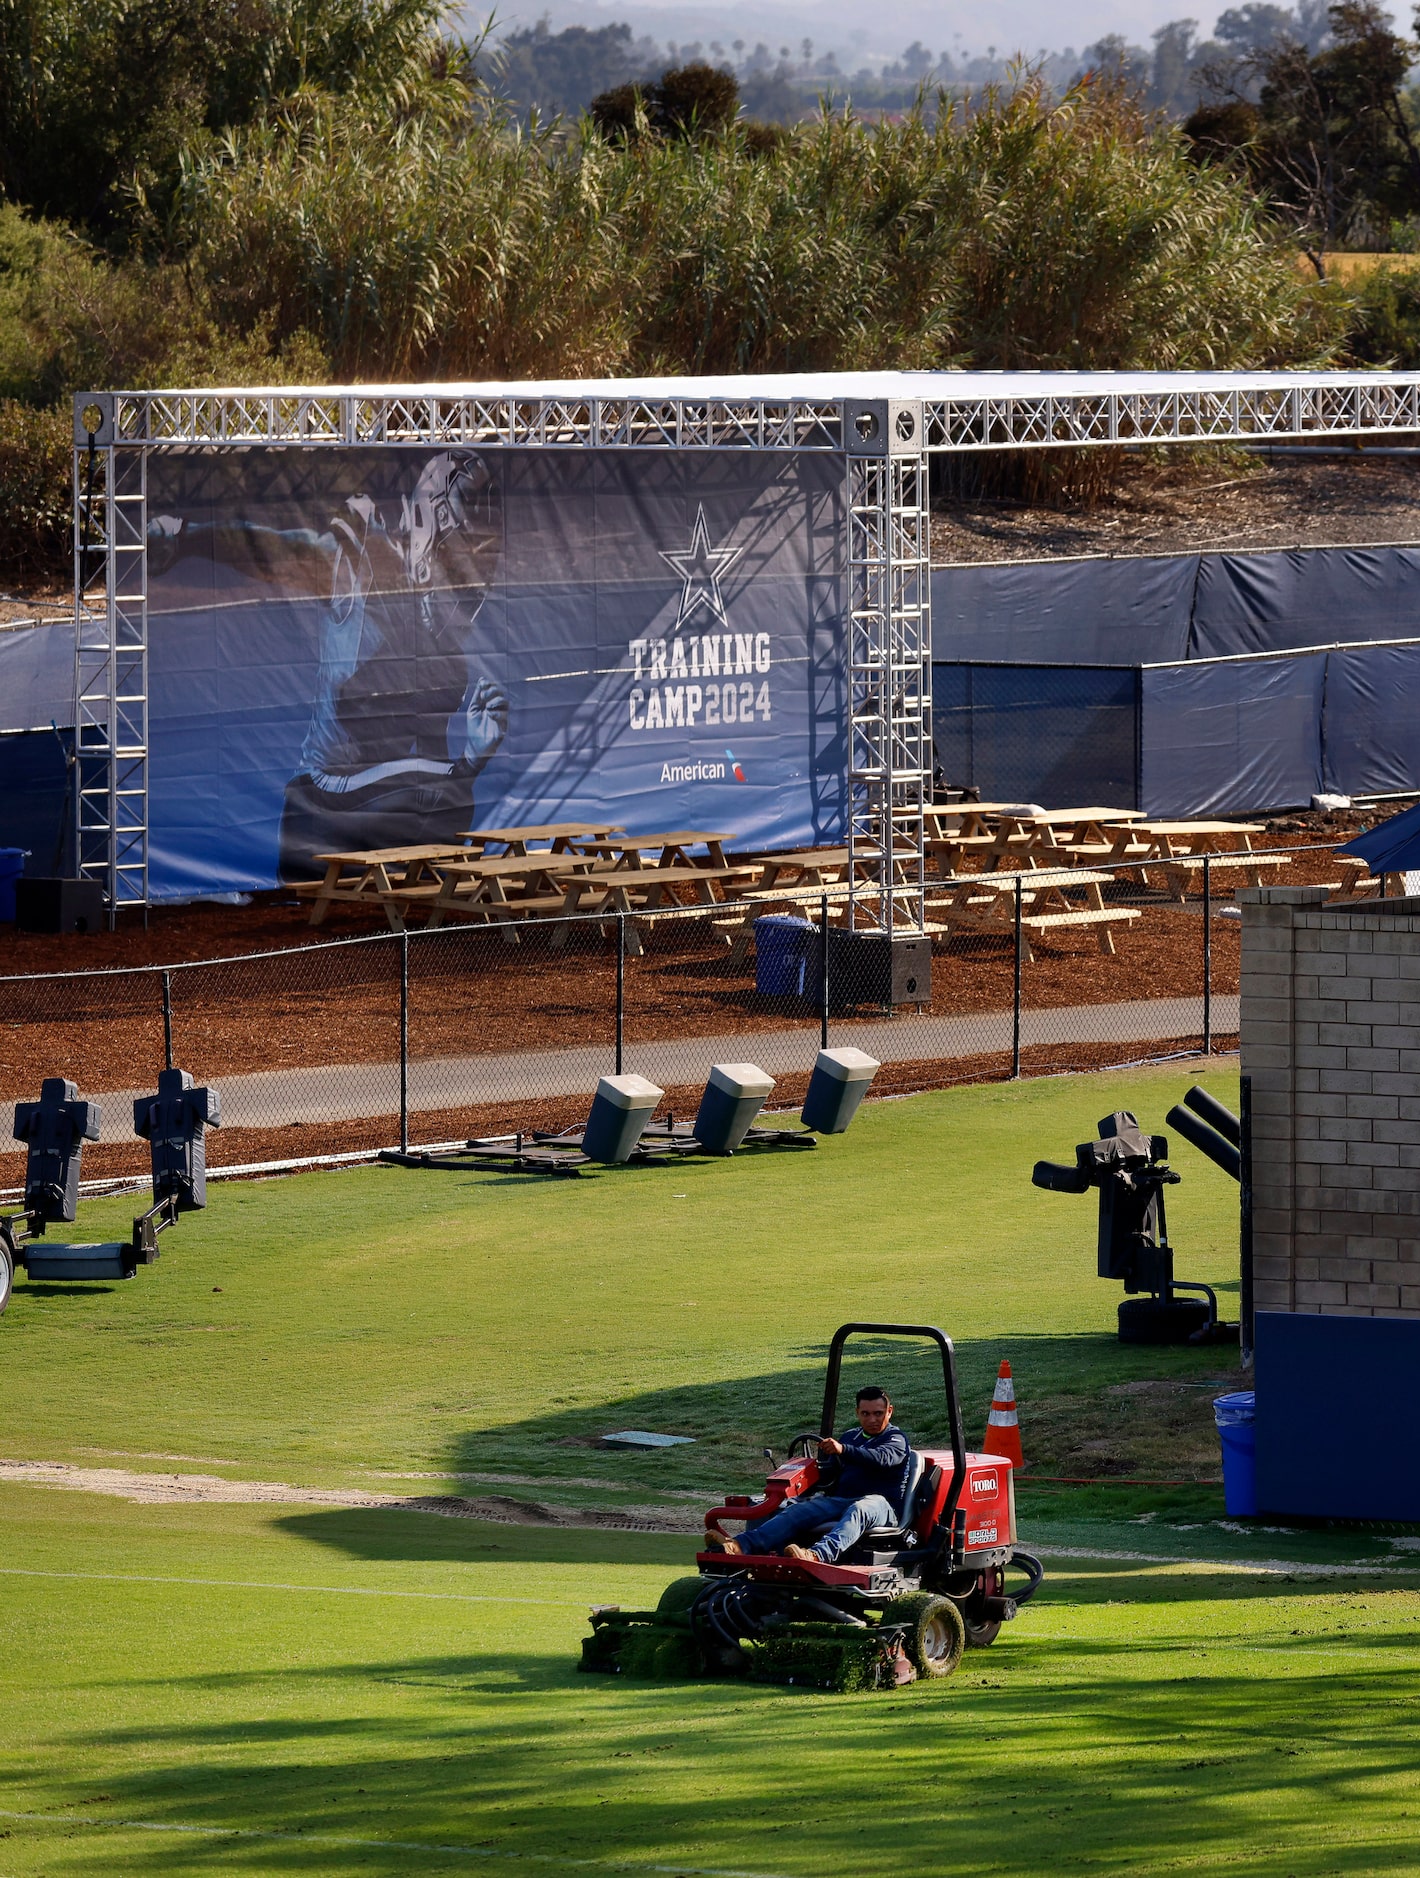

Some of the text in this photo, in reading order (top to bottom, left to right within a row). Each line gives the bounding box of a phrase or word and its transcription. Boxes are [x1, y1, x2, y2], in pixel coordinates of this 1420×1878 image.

[628, 632, 771, 681] TRAINING
[660, 760, 725, 783] American
[973, 1479, 996, 1492] TORO
